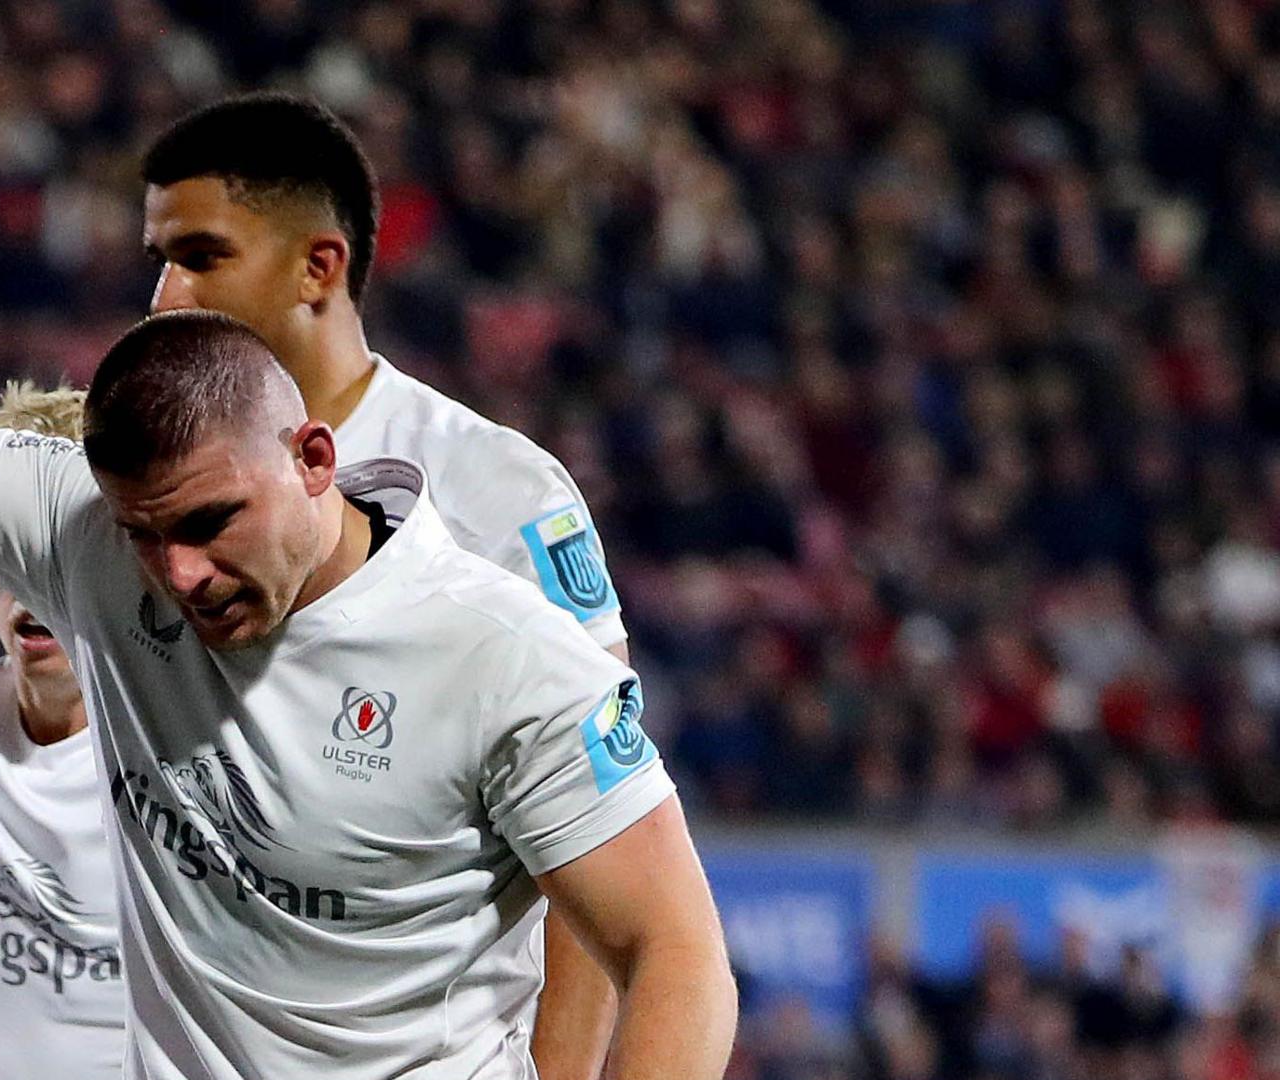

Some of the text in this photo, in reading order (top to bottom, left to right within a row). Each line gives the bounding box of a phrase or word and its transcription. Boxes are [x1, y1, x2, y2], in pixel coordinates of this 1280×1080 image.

[322, 745, 391, 772] ULSTER
[335, 764, 372, 783] Rugby
[110, 766, 346, 922] Kingspan
